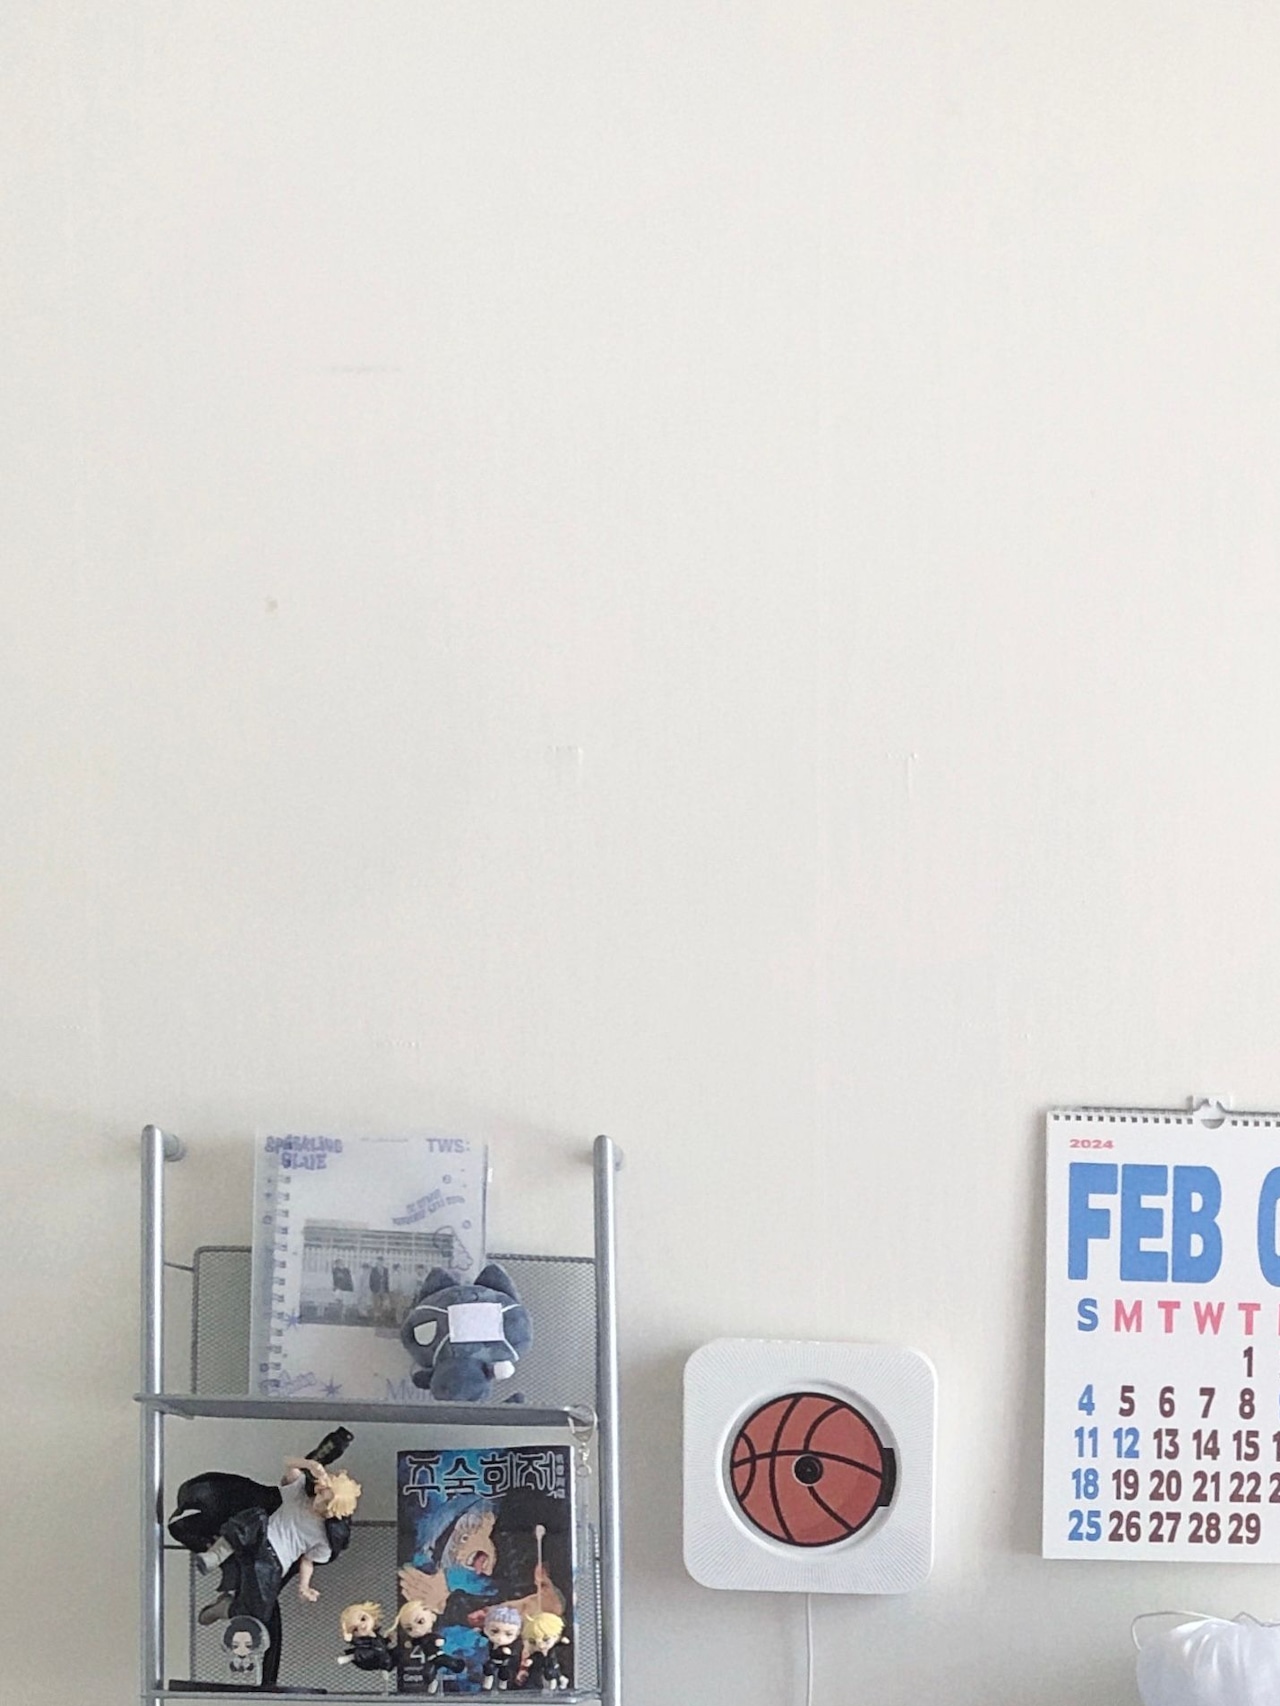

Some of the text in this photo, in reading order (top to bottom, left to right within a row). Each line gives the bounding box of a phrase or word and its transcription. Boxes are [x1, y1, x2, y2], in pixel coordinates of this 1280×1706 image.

[1070, 1139, 1114, 1149] 2024
[1068, 1162, 1223, 1283] FEB
[1077, 1298, 1099, 1332] S
[1114, 1299, 1143, 1333] M
[1158, 1301, 1181, 1334] T
[1193, 1301, 1225, 1335] W
[1238, 1303, 1261, 1336] T
[1243, 1346, 1254, 1378] 1
[1078, 1384, 1096, 1416] 4
[1119, 1385, 1136, 1418] 5
[1159, 1386, 1176, 1419] 6
[1199, 1387, 1216, 1419] 7
[1239, 1388, 1256, 1420] 8
[1074, 1427, 1099, 1458] 11
[1113, 1428, 1140, 1459] 12
[1153, 1428, 1180, 1460] 13
[1192, 1429, 1221, 1461] 14
[1232, 1430, 1260, 1462] 15
[1072, 1468, 1100, 1501] 18
[1112, 1469, 1140, 1501] 19
[1149, 1470, 1182, 1502] 20
[1192, 1471, 1221, 1503] 21
[1229, 1471, 1262, 1504] 22
[1068, 1510, 1262, 1545] 25 26 27 28 29
